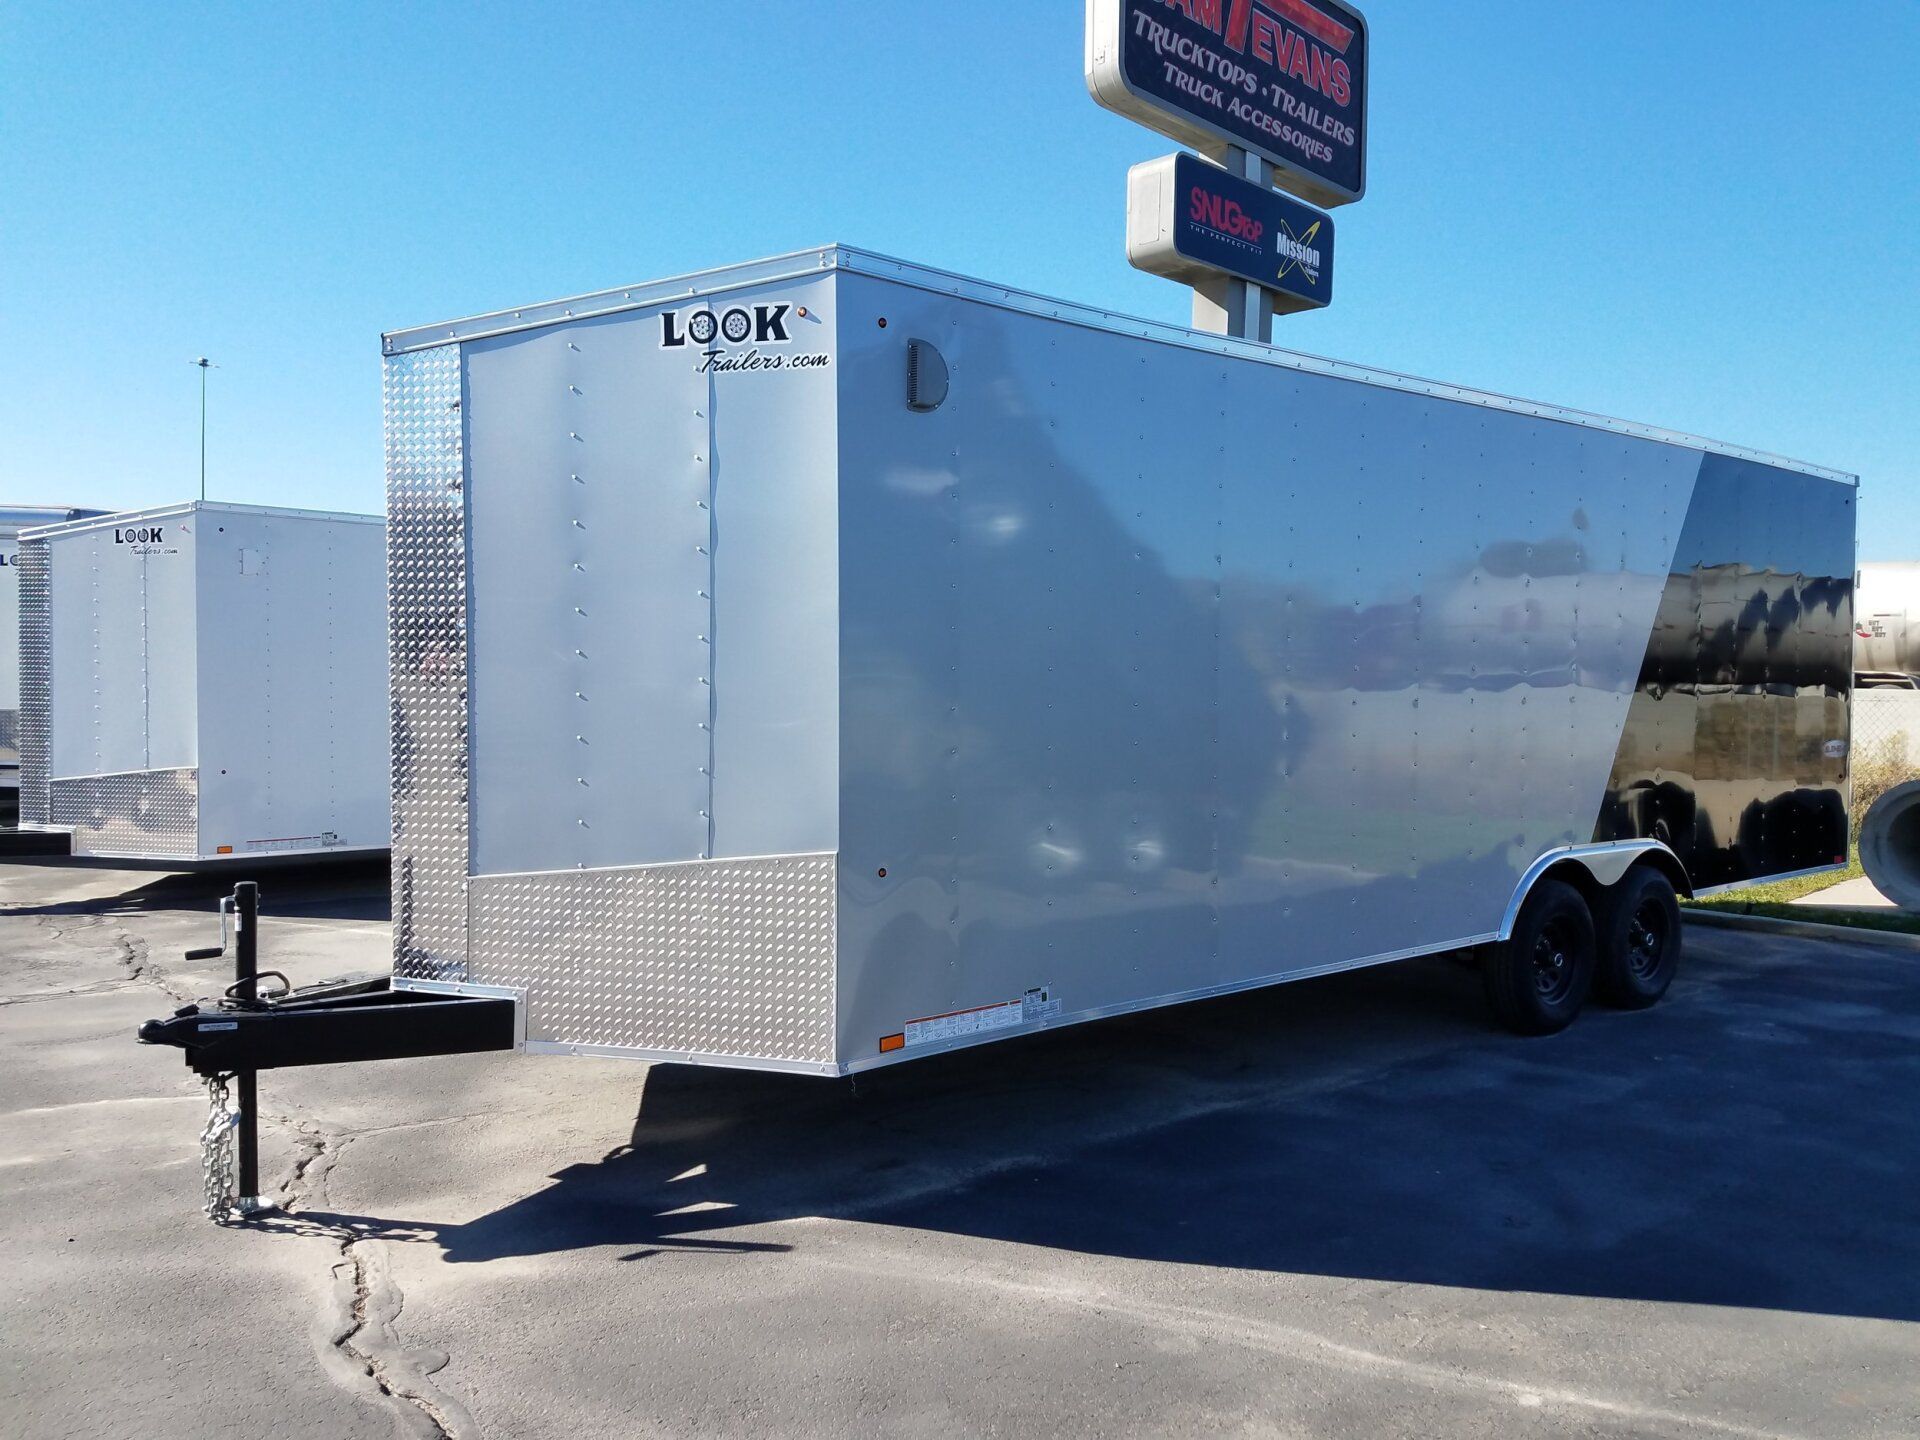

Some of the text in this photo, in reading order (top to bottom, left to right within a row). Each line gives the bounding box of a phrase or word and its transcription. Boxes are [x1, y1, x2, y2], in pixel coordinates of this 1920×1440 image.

[1252, 8, 1351, 107] EVANS
[1133, 10, 1257, 94] TRUCKTOPS
[1271, 84, 1354, 146] TRAILERS
[1163, 62, 1333, 163] TRUCK ACCESSORIES
[661, 304, 791, 347] LOOK
[701, 349, 829, 374] Trailers.com
[115, 527, 163, 544] LOOK
[129, 545, 178, 556] Trailers.com
[0, 554, 19, 567] LO
